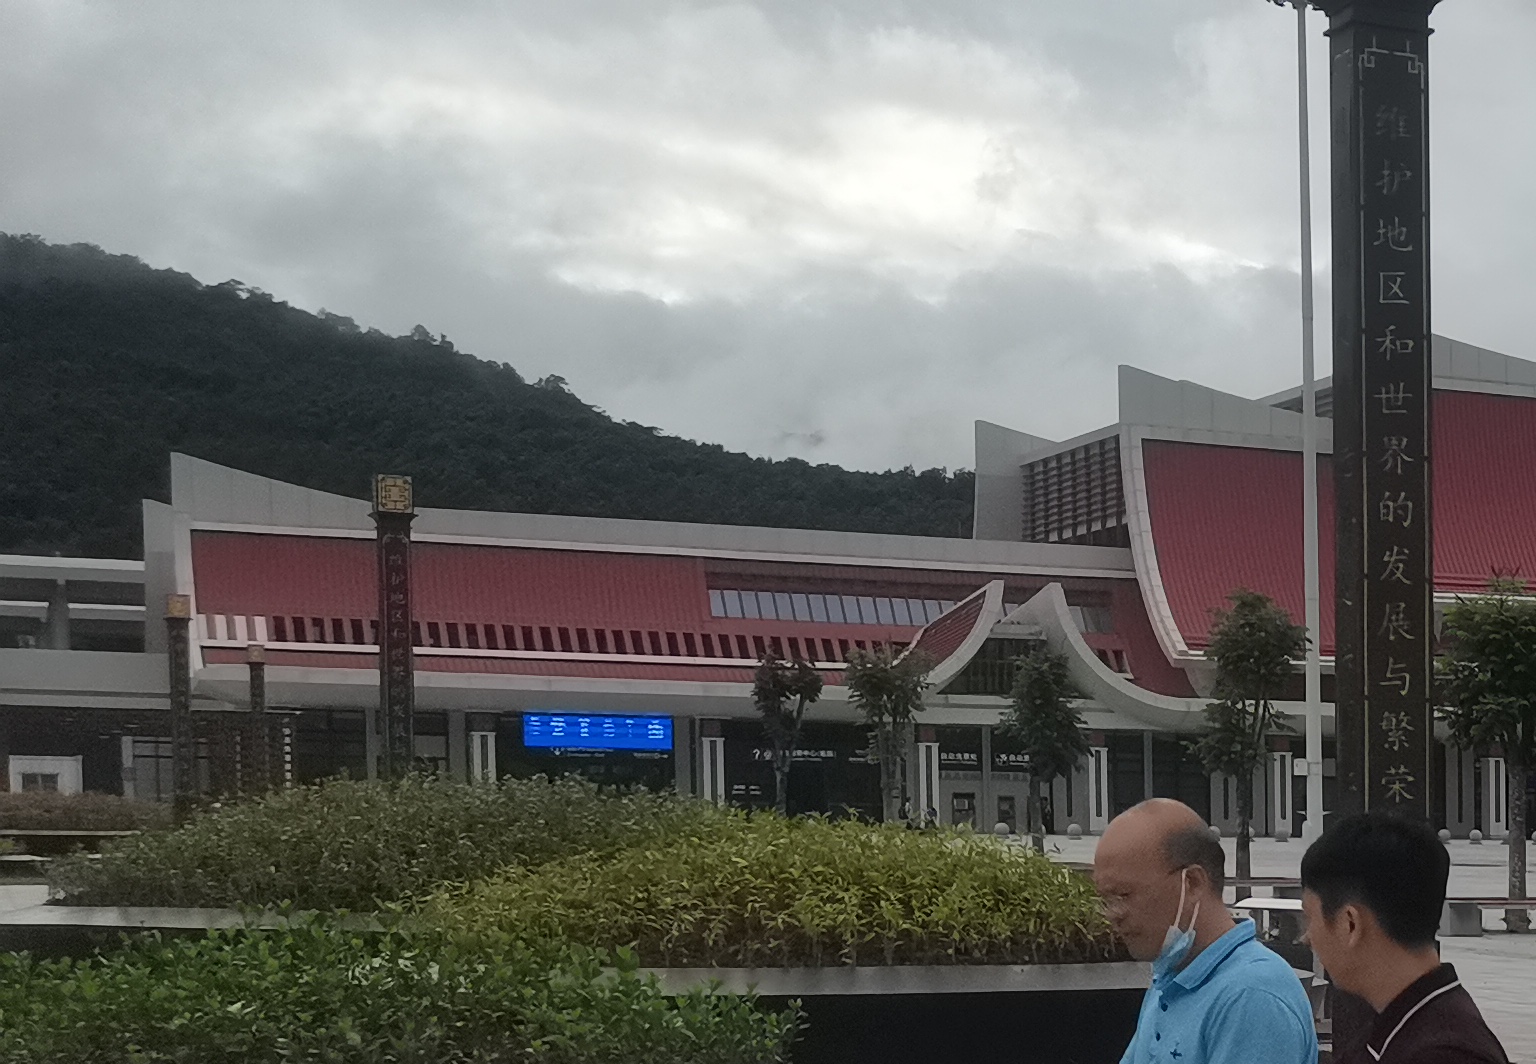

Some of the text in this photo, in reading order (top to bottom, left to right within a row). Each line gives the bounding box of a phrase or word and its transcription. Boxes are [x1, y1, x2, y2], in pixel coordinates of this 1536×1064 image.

[1373, 104, 1416, 803] 维护地区和世界的发展与繁荣
